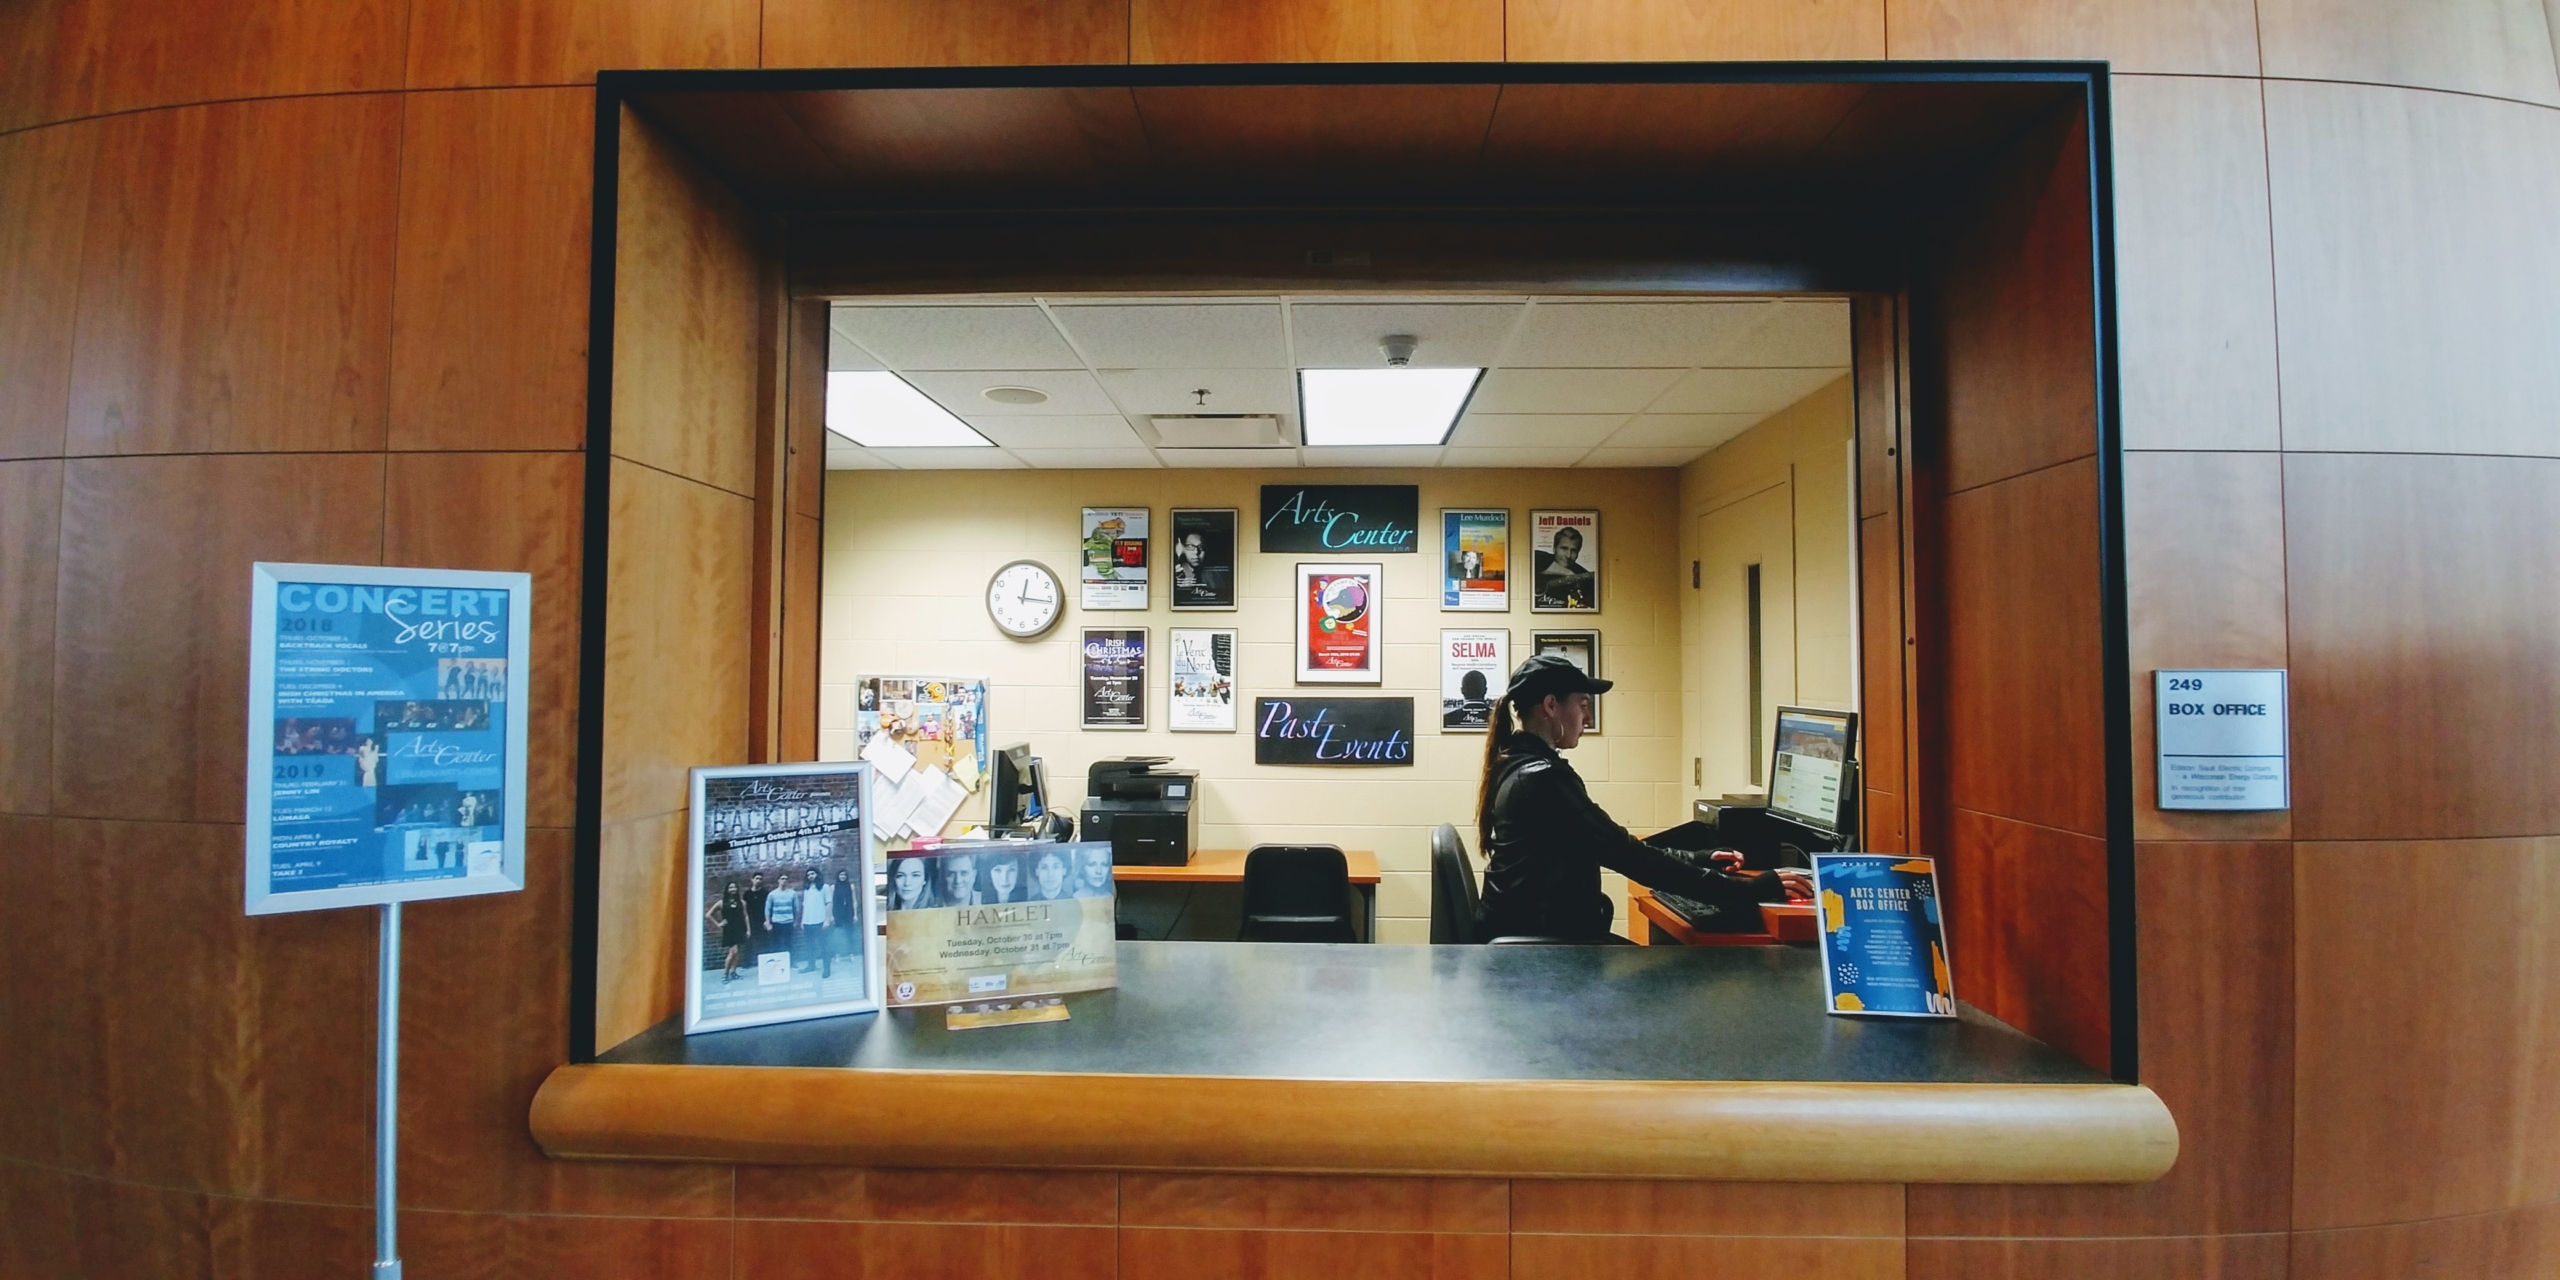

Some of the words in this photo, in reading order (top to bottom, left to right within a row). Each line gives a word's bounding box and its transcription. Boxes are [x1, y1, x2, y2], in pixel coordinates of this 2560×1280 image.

[1265, 490, 1335, 530] Arts
[1460, 513, 1473, 522] Lee
[1474, 513, 1505, 522] Murdock
[1538, 515, 1555, 526] Jeff
[1556, 515, 1591, 526] Daniels
[1322, 511, 1413, 549] Center
[995, 580, 1005, 588] 10
[1044, 581, 1050, 589] 2
[280, 584, 506, 616] CONCERT
[994, 593, 1000, 602] 9
[997, 607, 1003, 615] 8
[281, 618, 333, 632] 2018
[385, 599, 500, 644] Series
[1019, 621, 1025, 629] 6
[1033, 617, 1039, 626] 5
[1086, 642, 1141, 658] CHRISTMAS
[1105, 638, 1125, 647] IRISH
[1176, 645, 1184, 658] Le
[1183, 639, 1207, 657] Vent
[1452, 642, 1496, 658] SELMA
[1186, 656, 1211, 673] Nord
[1094, 686, 1113, 697] Arts
[2169, 678, 2203, 691] 249
[1109, 691, 1136, 702] Center
[2169, 703, 2205, 715] BOX
[2212, 704, 2267, 715] OFFICE
[1259, 702, 1327, 739] Past
[393, 735, 442, 757] Arts
[1315, 723, 1409, 760] Events
[434, 745, 497, 766] Center
[275, 764, 325, 779] 2019
[2229, 773, 2250, 781] Energy
[273, 789, 302, 797] JENNY
[740, 780, 772, 799] Arts
[767, 786, 808, 802] Center
[713, 802, 857, 834] BACKTRACK
[272, 841, 317, 849] COUNTRY
[318, 838, 359, 846] ROYALTY
[728, 837, 767, 848] Thursday,
[767, 832, 798, 841] October
[798, 828, 813, 836] 4th
[813, 826, 822, 834] at
[822, 824, 839, 833] 7pm
[740, 835, 831, 863] VOCALS
[1850, 887, 1874, 898] ARTS
[1877, 888, 1911, 900] CENTER
[1856, 899, 1874, 911] BOX
[1877, 900, 1909, 912] OFFICE
[957, 905, 1052, 926] HAMLET
[946, 938, 985, 947] Tuesday,
[987, 934, 1021, 944] October
[1022, 933, 1033, 941] 30
[1035, 932, 1043, 940] at
[1045, 931, 1063, 941] 7pm
[940, 948, 992, 958] Wednesday,
[994, 944, 1028, 954] October
[1030, 943, 1039, 951] 31
[1042, 942, 1050, 950] at
[1052, 941, 1070, 951] 7pm
[1081, 952, 1113, 966] Center
